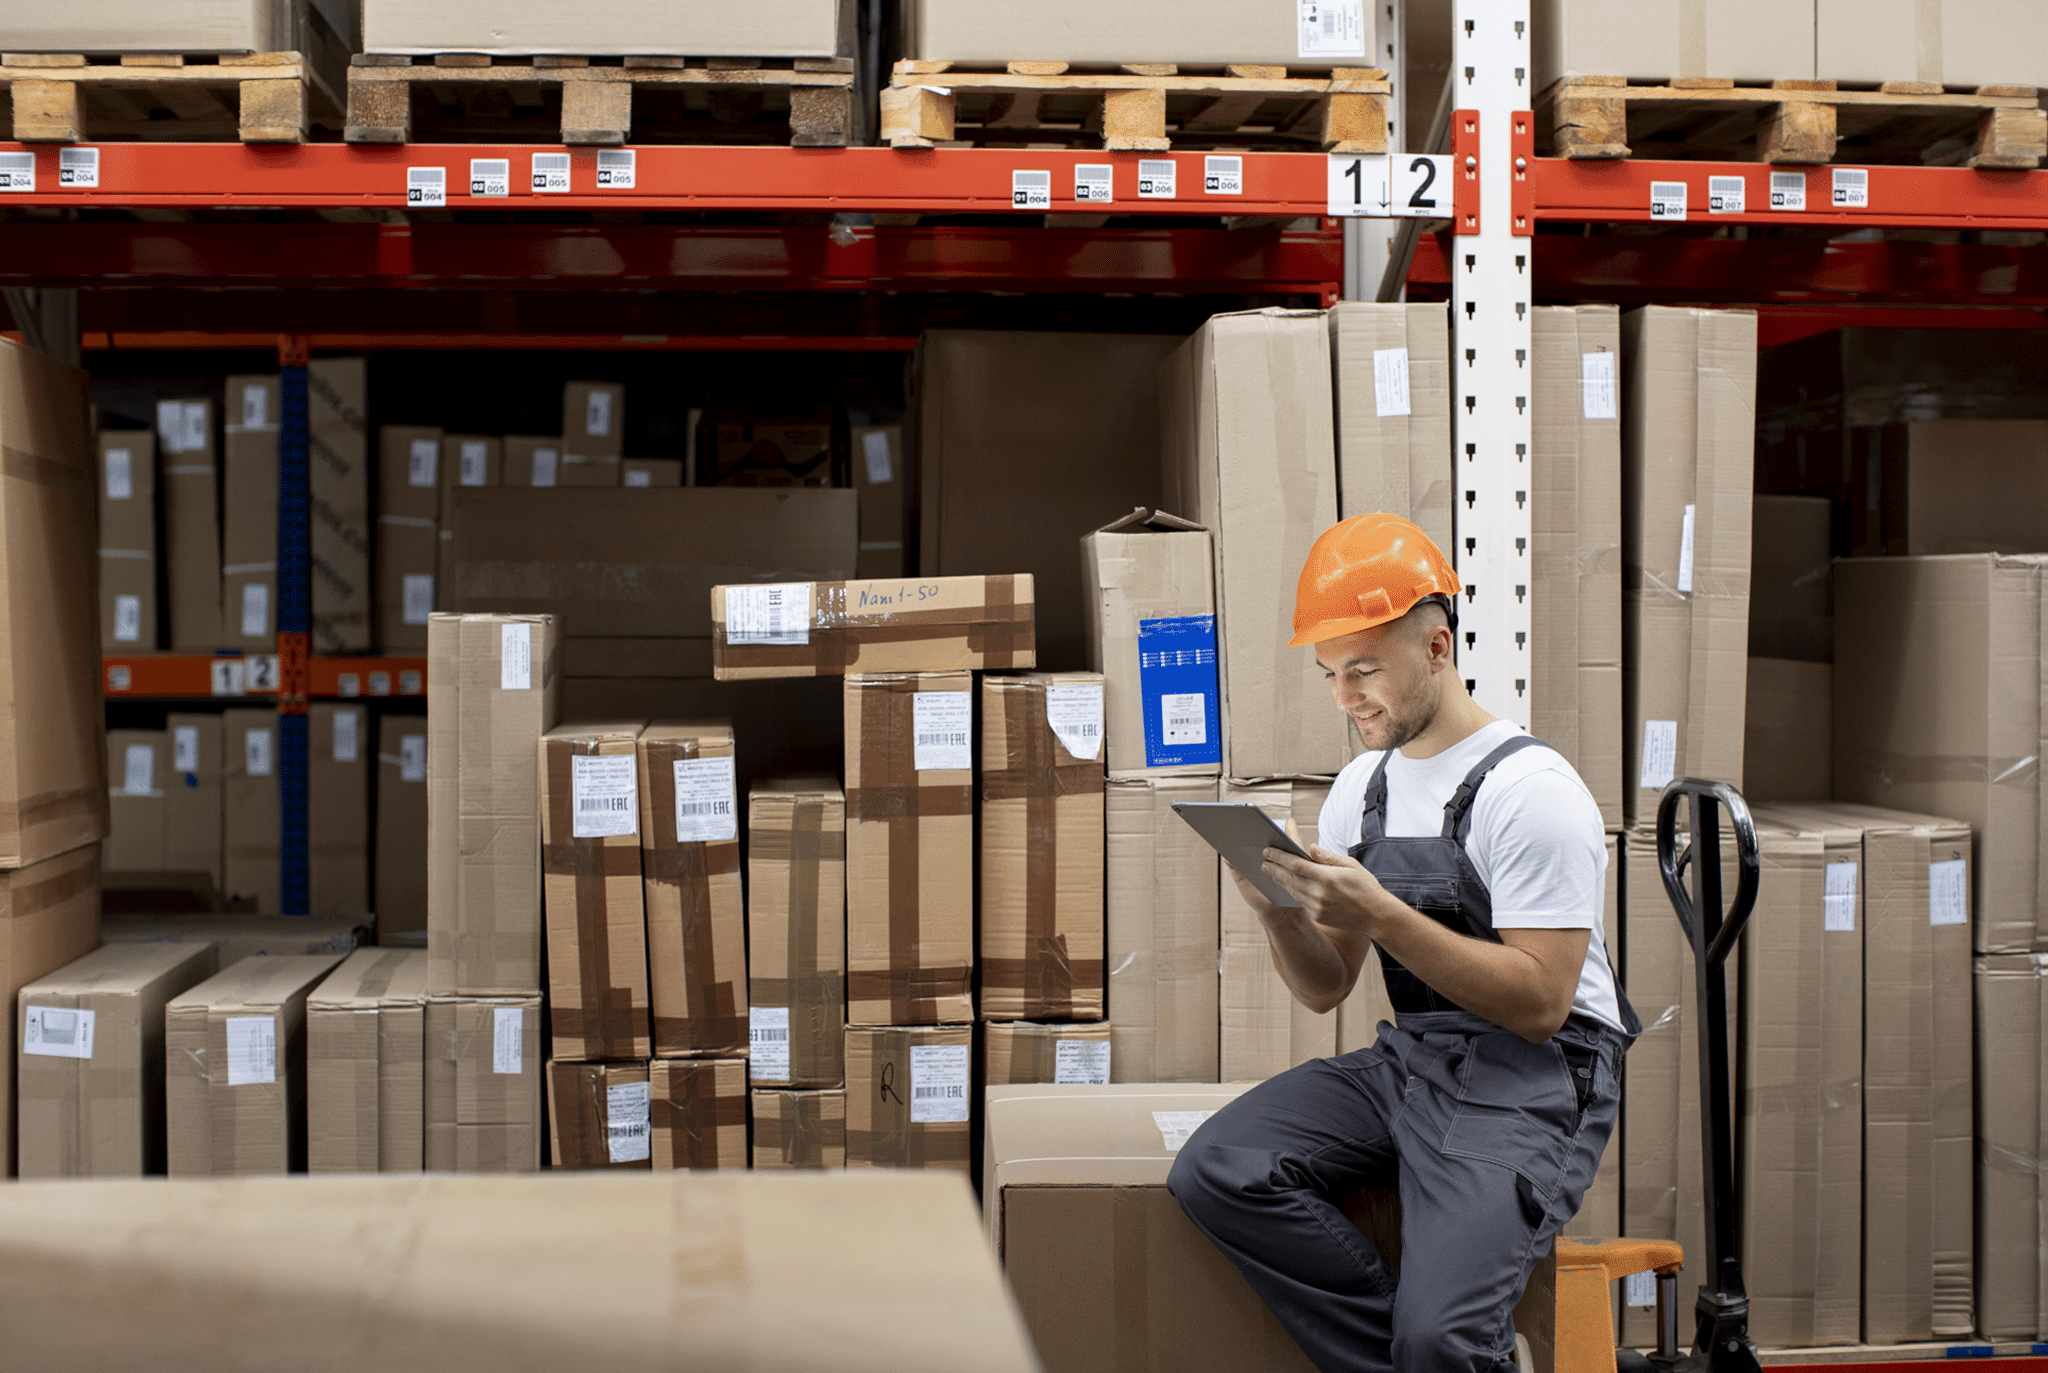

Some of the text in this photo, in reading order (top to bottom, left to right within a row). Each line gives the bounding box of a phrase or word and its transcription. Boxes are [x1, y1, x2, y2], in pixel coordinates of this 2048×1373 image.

[76, 174, 94, 182] 004
[613, 175, 632, 183] 005
[1345, 159, 1361, 204] 1
[548, 179, 566, 187] 005
[1221, 182, 1239, 190] 006
[1408, 157, 1436, 208] 2
[486, 185, 505, 193] 005
[1154, 185, 1172, 193] 006
[424, 193, 442, 201] 004
[1091, 190, 1109, 198] 006
[1848, 194, 1865, 202] 007
[1724, 201, 1742, 209] 007
[1666, 207, 1684, 215] 007
[256, 656, 272, 687] 2
[220, 666, 232, 690] 1
[1083, 724, 1097, 736] EAC
[950, 733, 966, 746] EAC
[612, 797, 628, 810] EAC
[713, 801, 730, 814] EAC
[947, 1086, 962, 1098] EAC
